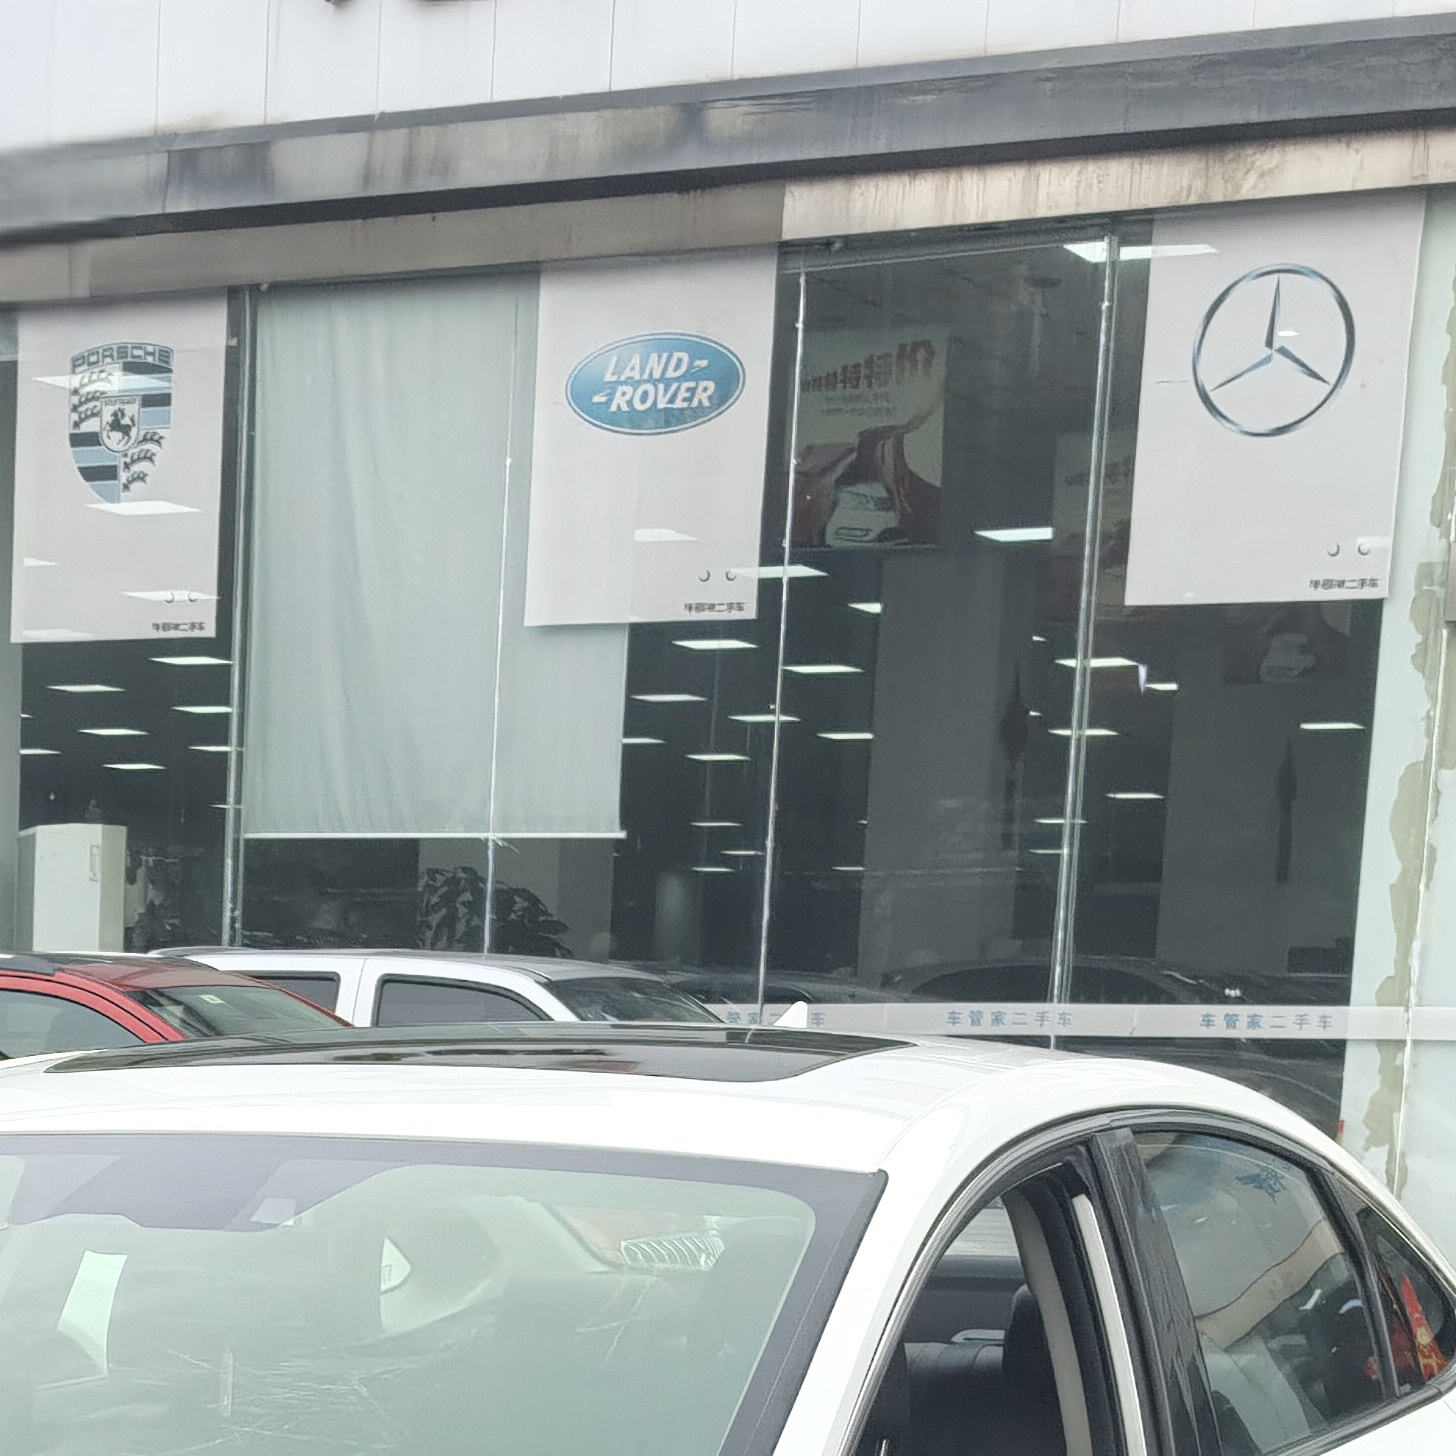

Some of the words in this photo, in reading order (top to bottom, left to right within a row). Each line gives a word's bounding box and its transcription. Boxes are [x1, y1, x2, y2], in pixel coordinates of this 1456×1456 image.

[72, 345, 172, 373] PORSCHE
[604, 351, 690, 382] LAND
[609, 380, 716, 412] ROVER
[946, 1010, 1073, 1027] 车管家二手车
[1200, 1012, 1333, 1030] 车管家二手车
